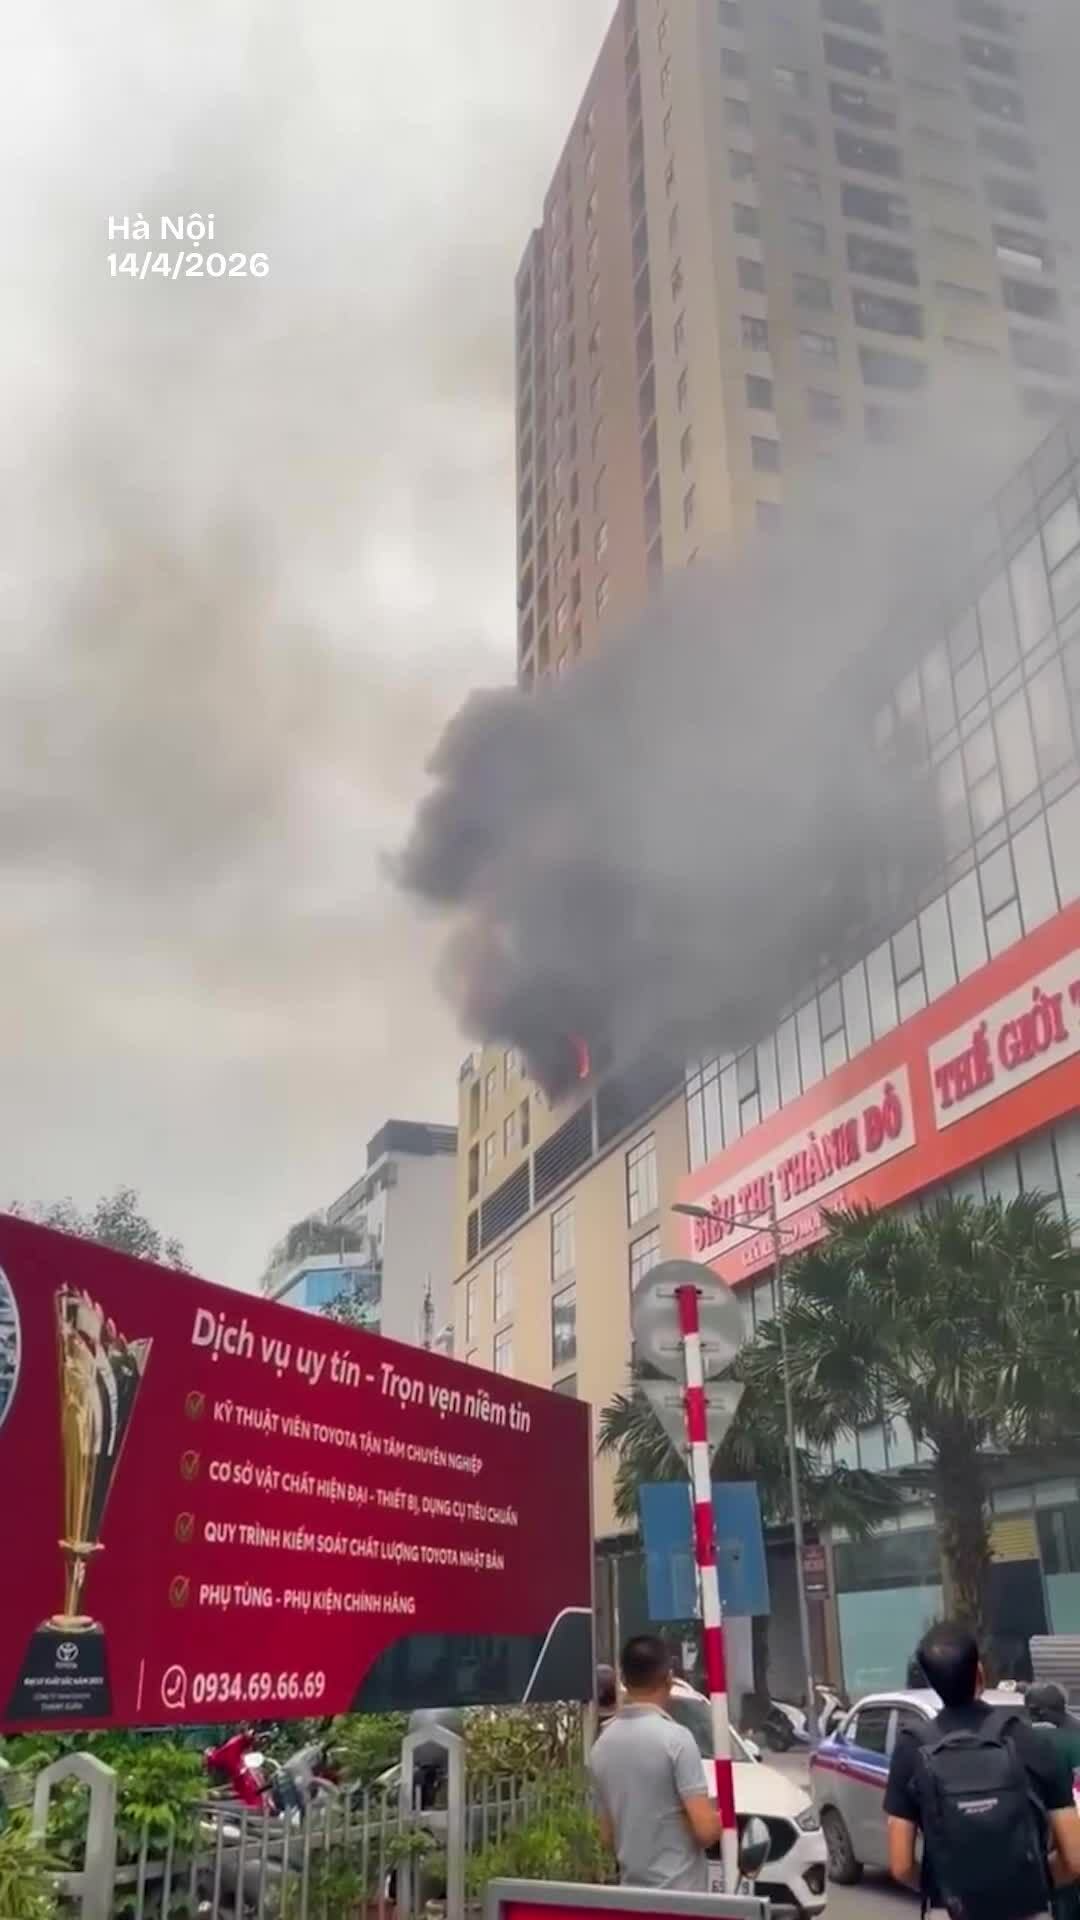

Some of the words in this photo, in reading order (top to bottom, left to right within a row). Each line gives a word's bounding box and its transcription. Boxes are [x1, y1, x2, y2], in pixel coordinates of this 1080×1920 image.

[935, 1020, 995, 1110] THẾ
[997, 986, 1069, 1072] GIỚI
[777, 1117, 861, 1202] THÀNH
[191, 1307, 254, 1362] Dịch
[261, 1336, 292, 1378] vụ
[296, 1347, 327, 1385] uy
[330, 1350, 361, 1387] tín
[365, 1373, 375, 1382] -
[381, 1362, 424, 1411] Trọn
[428, 1383, 460, 1420] vẹn
[464, 1388, 506, 1426] niềm
[509, 1402, 532, 1433] tin
[213, 1399, 234, 1424] KỸ
[235, 1405, 280, 1437] THUẬT
[281, 1414, 311, 1440] VIÊN
[312, 1423, 358, 1450] TOYOTA
[359, 1430, 382, 1457] TẬN
[383, 1436, 406, 1459] TÂM
[407, 1443, 447, 1467] CHUYÊN
[448, 1452, 483, 1478] NGHIỆP
[209, 1460, 232, 1482] CƠ
[233, 1459, 254, 1485] SỞ
[255, 1464, 280, 1494] VẬT
[281, 1471, 316, 1496] CHẤT
[316, 1476, 347, 1504] HIỆN
[347, 1482, 369, 1509] ĐẠI
[376, 1487, 407, 1510] THIẾT
[422, 1495, 451, 1519] DỤNG
[452, 1500, 466, 1523] CỤ
[467, 1500, 487, 1521] TIÊU
[203, 1520, 237, 1544] QUY
[238, 1521, 281, 1548] TRÌNH
[282, 1524, 315, 1552] KIỂM
[316, 1532, 349, 1555] SOÁT
[350, 1535, 380, 1559] CHẤT
[381, 1540, 419, 1566] LƯỢNG
[420, 1546, 459, 1566] TOYOTA
[459, 1547, 485, 1572] NHẬT
[485, 1549, 505, 1570] BẢN
[199, 1584, 231, 1612] PHỤ
[233, 1581, 273, 1608] TÙNG
[283, 1588, 311, 1614] PHỤ
[313, 1587, 342, 1615] KIỆN
[343, 1590, 382, 1613] CHÍNH
[193, 1670, 326, 1703] 0934.69.66.69
